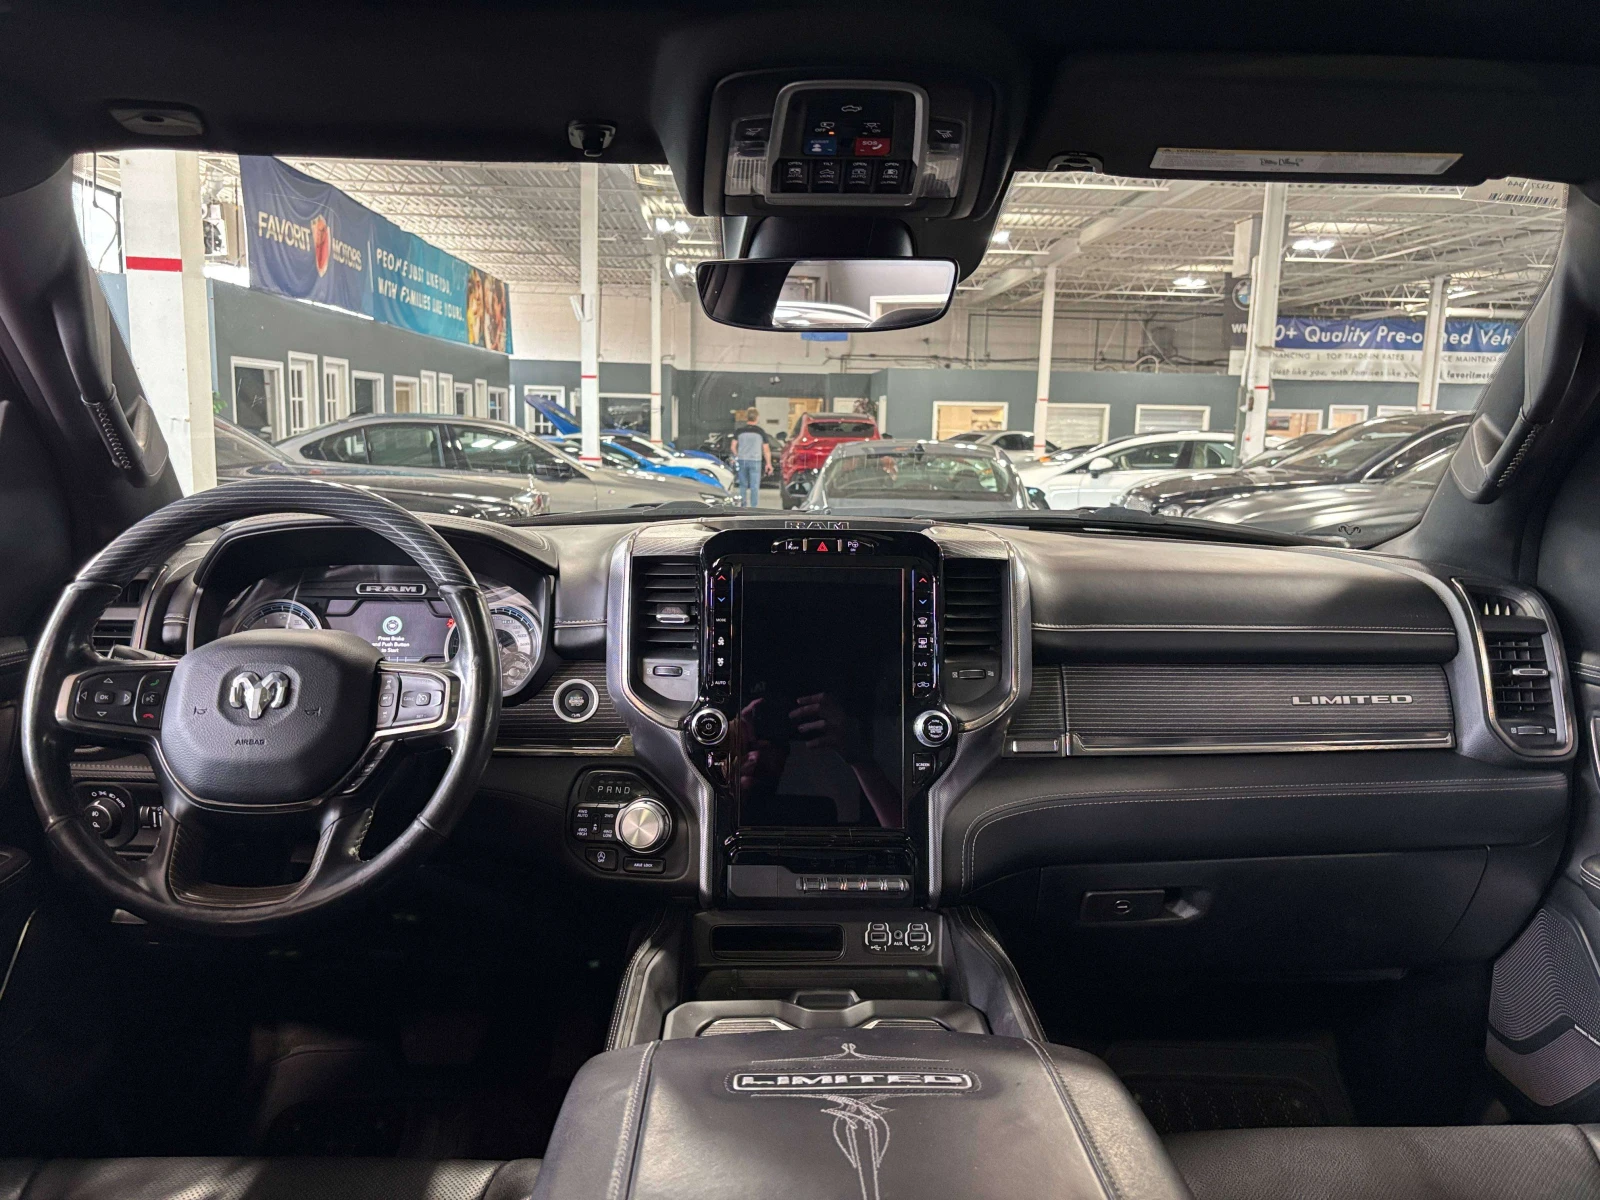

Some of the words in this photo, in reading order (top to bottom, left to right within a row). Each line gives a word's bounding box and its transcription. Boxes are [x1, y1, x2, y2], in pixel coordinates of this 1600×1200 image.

[258, 211, 311, 252] FAVORIT
[332, 237, 362, 272] MOTORS
[409, 263, 425, 284] JUST
[426, 270, 439, 289] LIKE
[378, 277, 398, 300] WITH
[400, 286, 431, 311] FAMILIES
[432, 298, 443, 315] LIKE
[1304, 325, 1372, 347] Quality
[784, 520, 850, 530] RAM
[366, 585, 418, 593] RAM
[1292, 695, 1413, 705] LIMITED
[234, 738, 266, 746] AIRBAG
[741, 1074, 963, 1087] LIMITED
